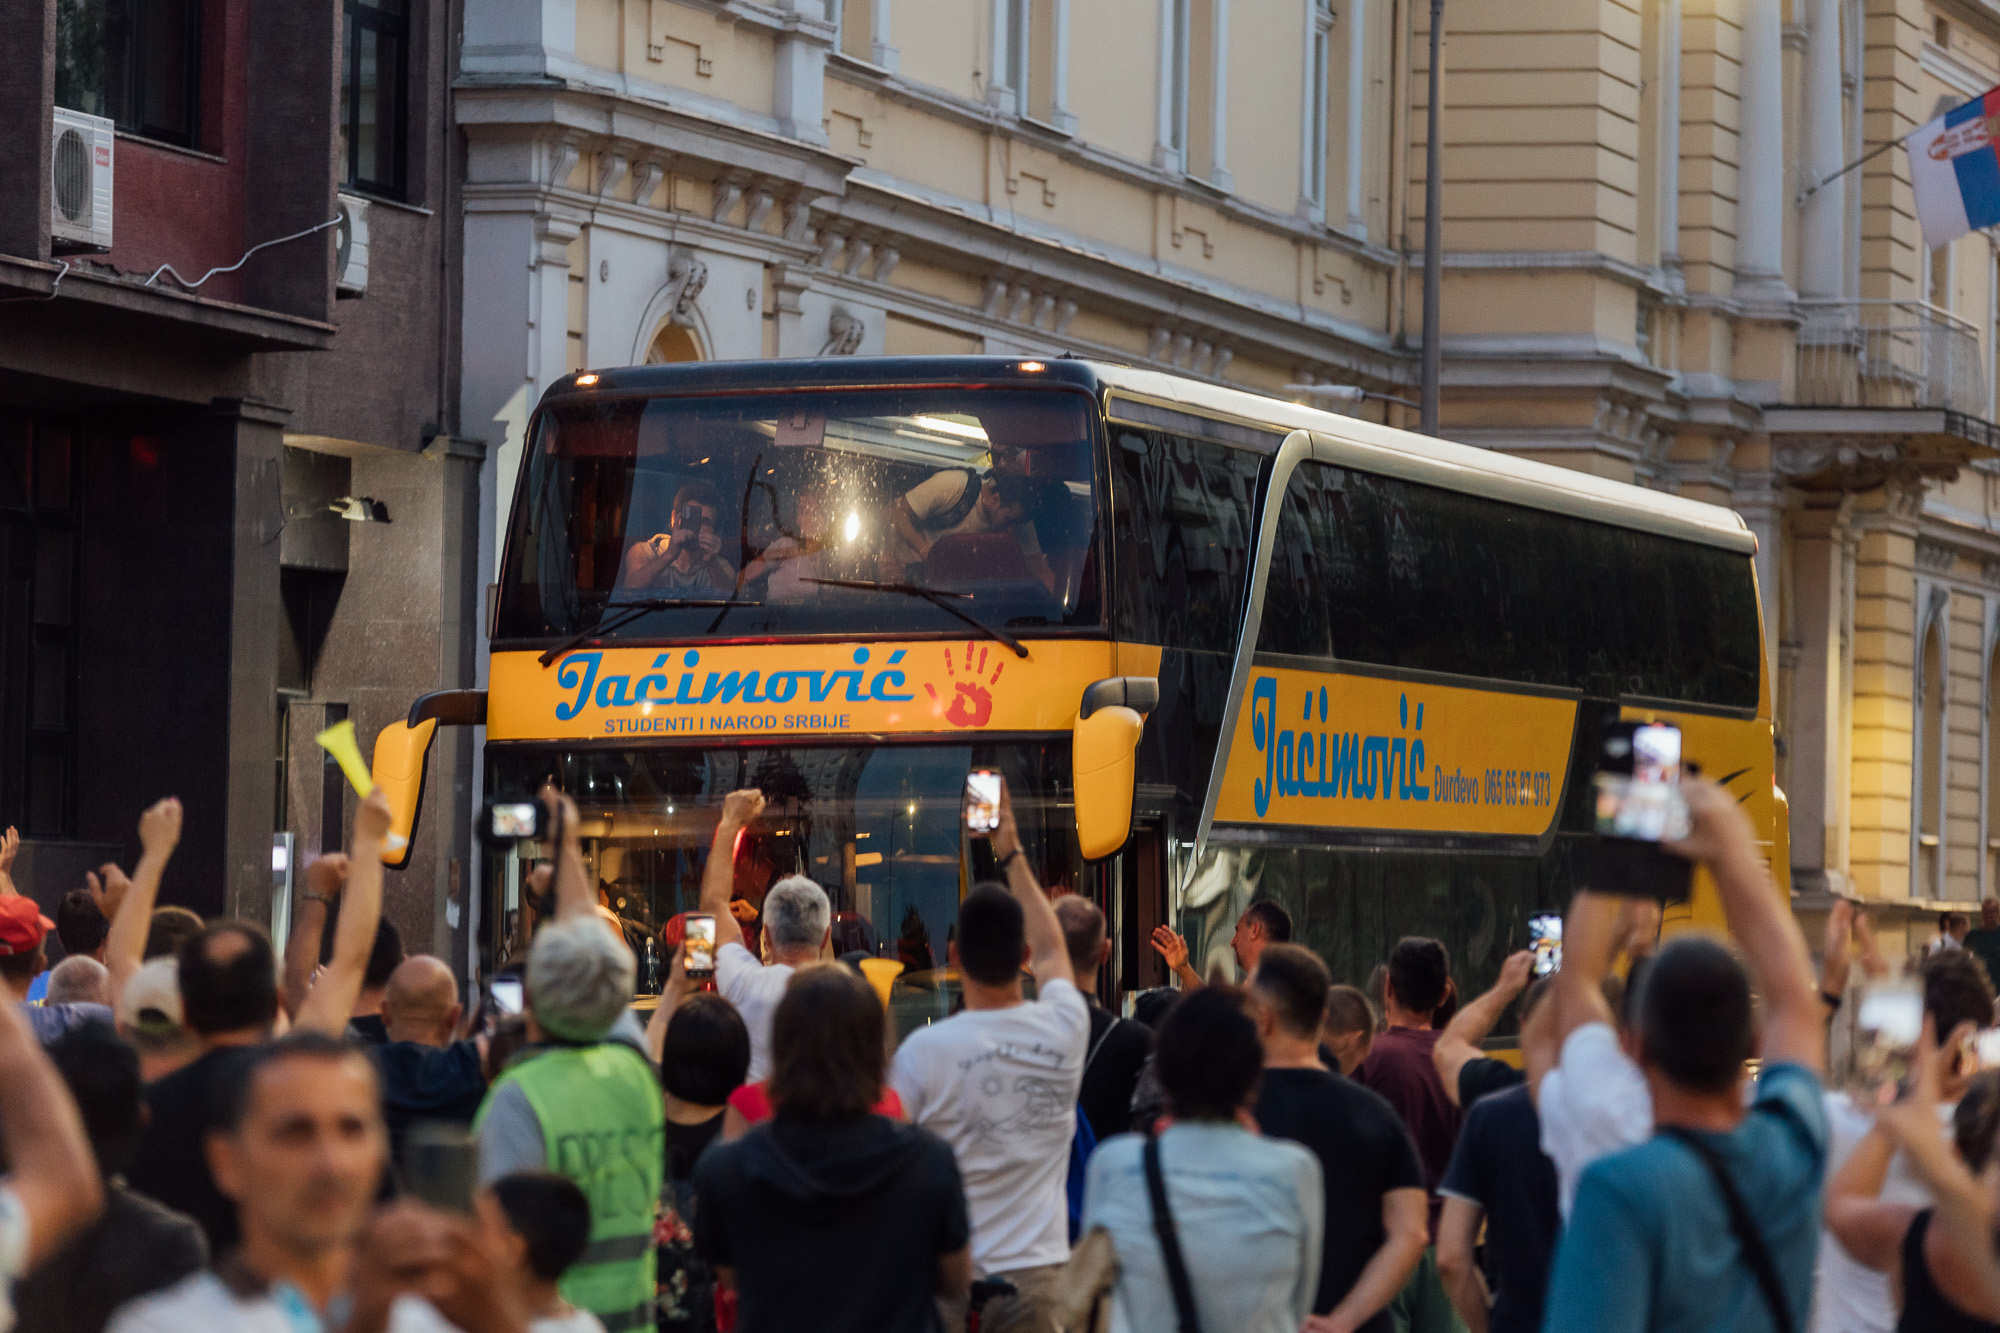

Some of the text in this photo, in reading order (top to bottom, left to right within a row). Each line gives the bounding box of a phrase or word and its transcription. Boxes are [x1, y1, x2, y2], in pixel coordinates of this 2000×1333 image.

[555, 646, 915, 722] Jaćimović
[604, 713, 851, 733] STUDENTI I NAROD SRBIJE
[1252, 676, 1430, 818] Jaćimović
[1434, 764, 1551, 807] Đurđevo 065 65 87 973
